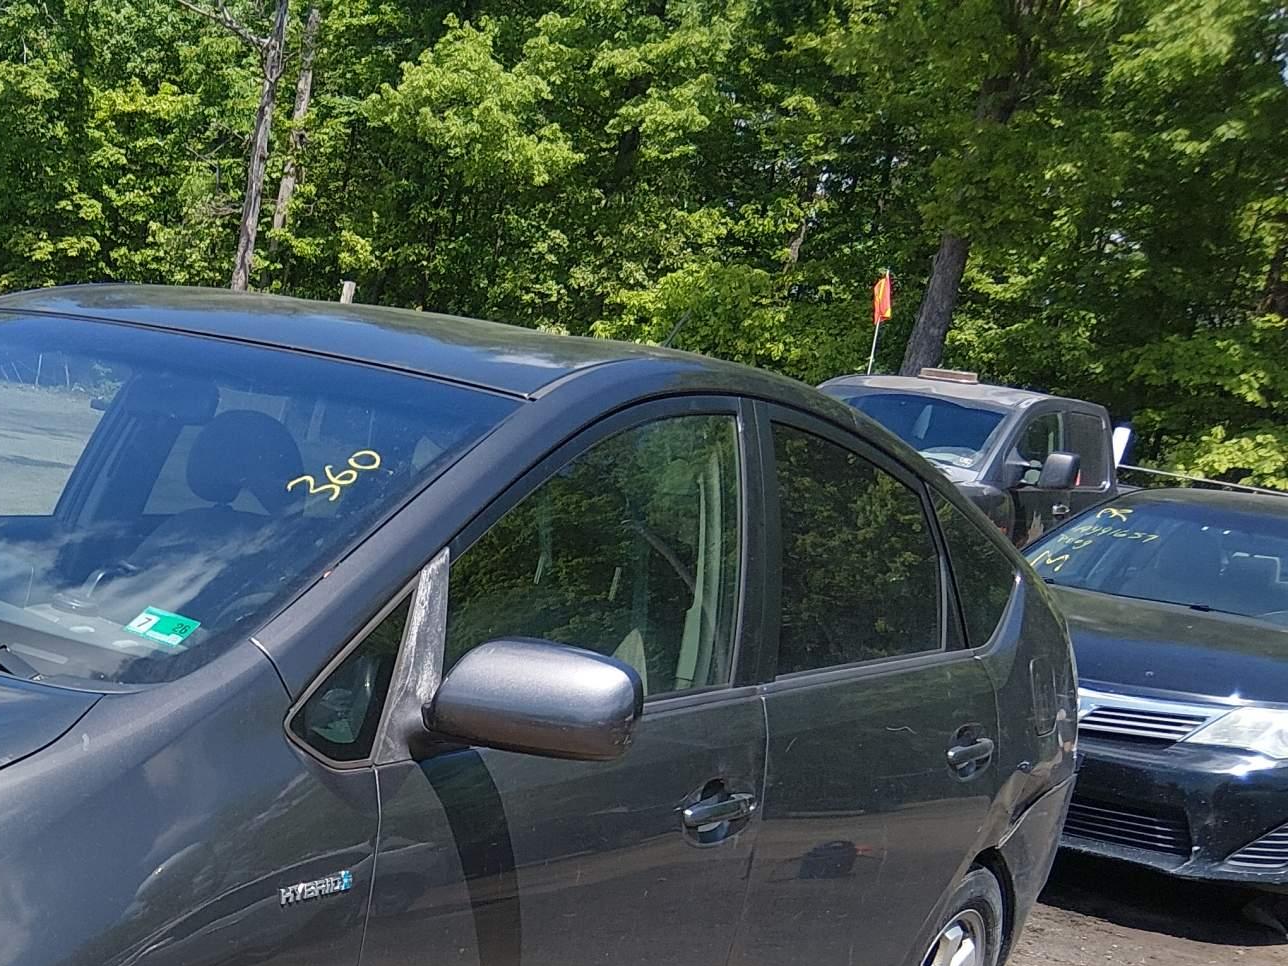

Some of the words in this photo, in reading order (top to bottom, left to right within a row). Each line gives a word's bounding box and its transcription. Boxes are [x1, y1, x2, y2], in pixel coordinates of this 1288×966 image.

[286, 449, 381, 501] 360
[137, 616, 153, 628] 7
[172, 622, 191, 635] 26
[279, 876, 343, 905] HYBRID
